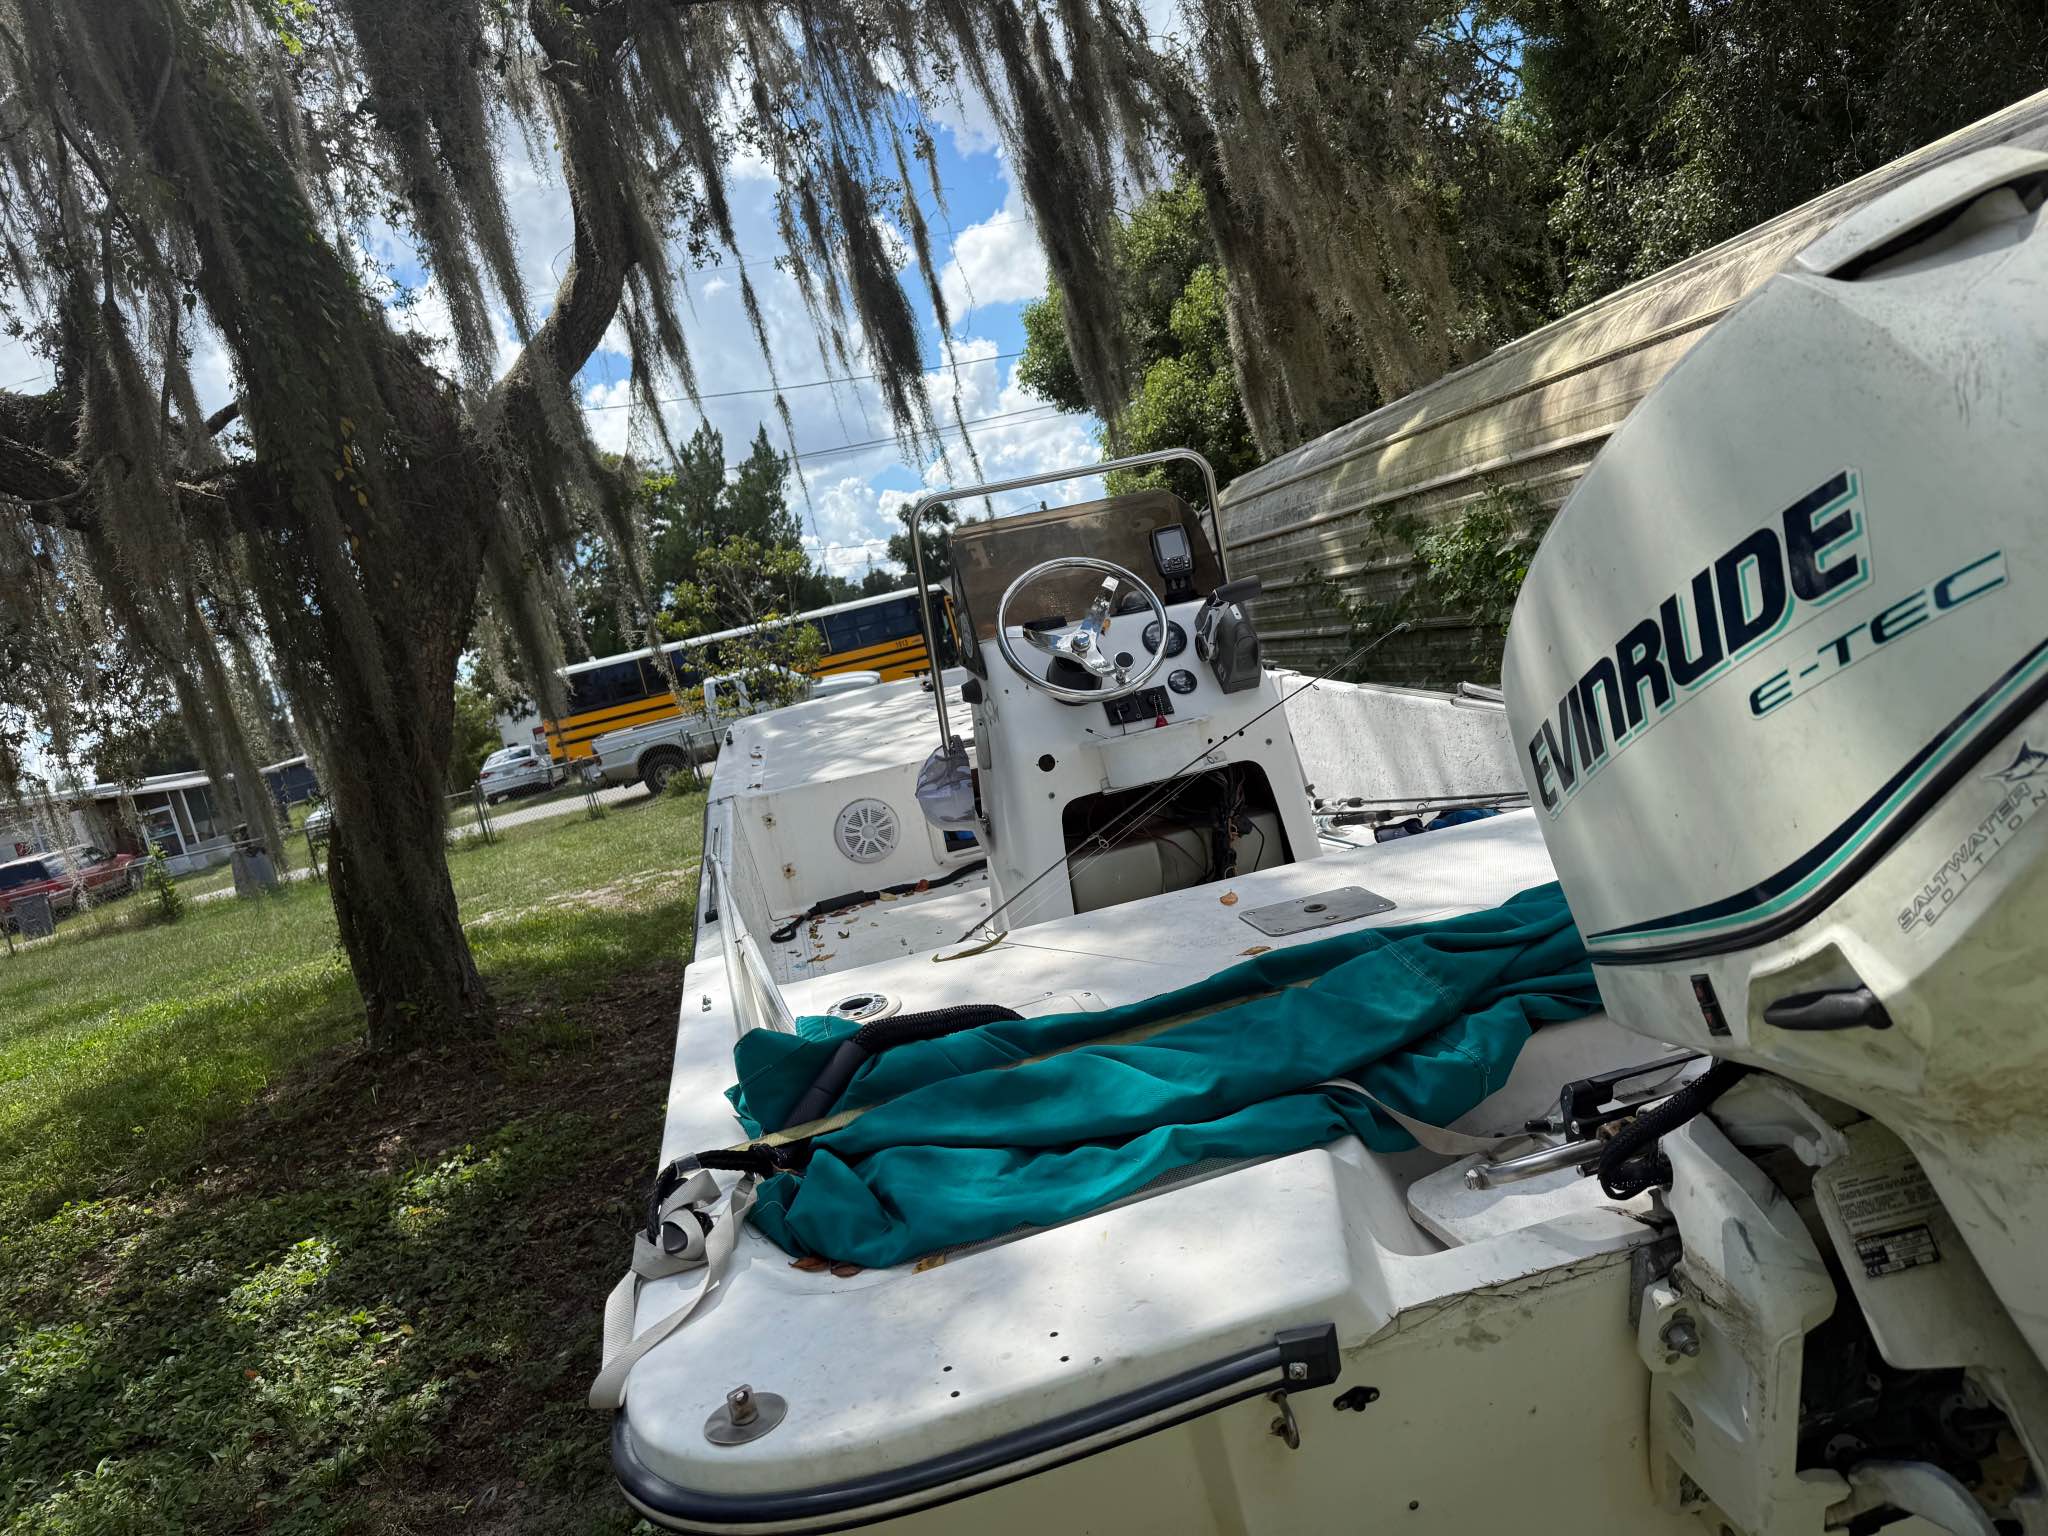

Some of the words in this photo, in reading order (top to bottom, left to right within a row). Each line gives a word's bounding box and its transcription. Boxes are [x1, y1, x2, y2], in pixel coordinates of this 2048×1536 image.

[1528, 469, 1868, 816] EVINRUDE
[1749, 550, 2005, 716] E-TEC
[1897, 782, 2032, 932] SALTWATER
[1926, 788, 2047, 924] EDITION
